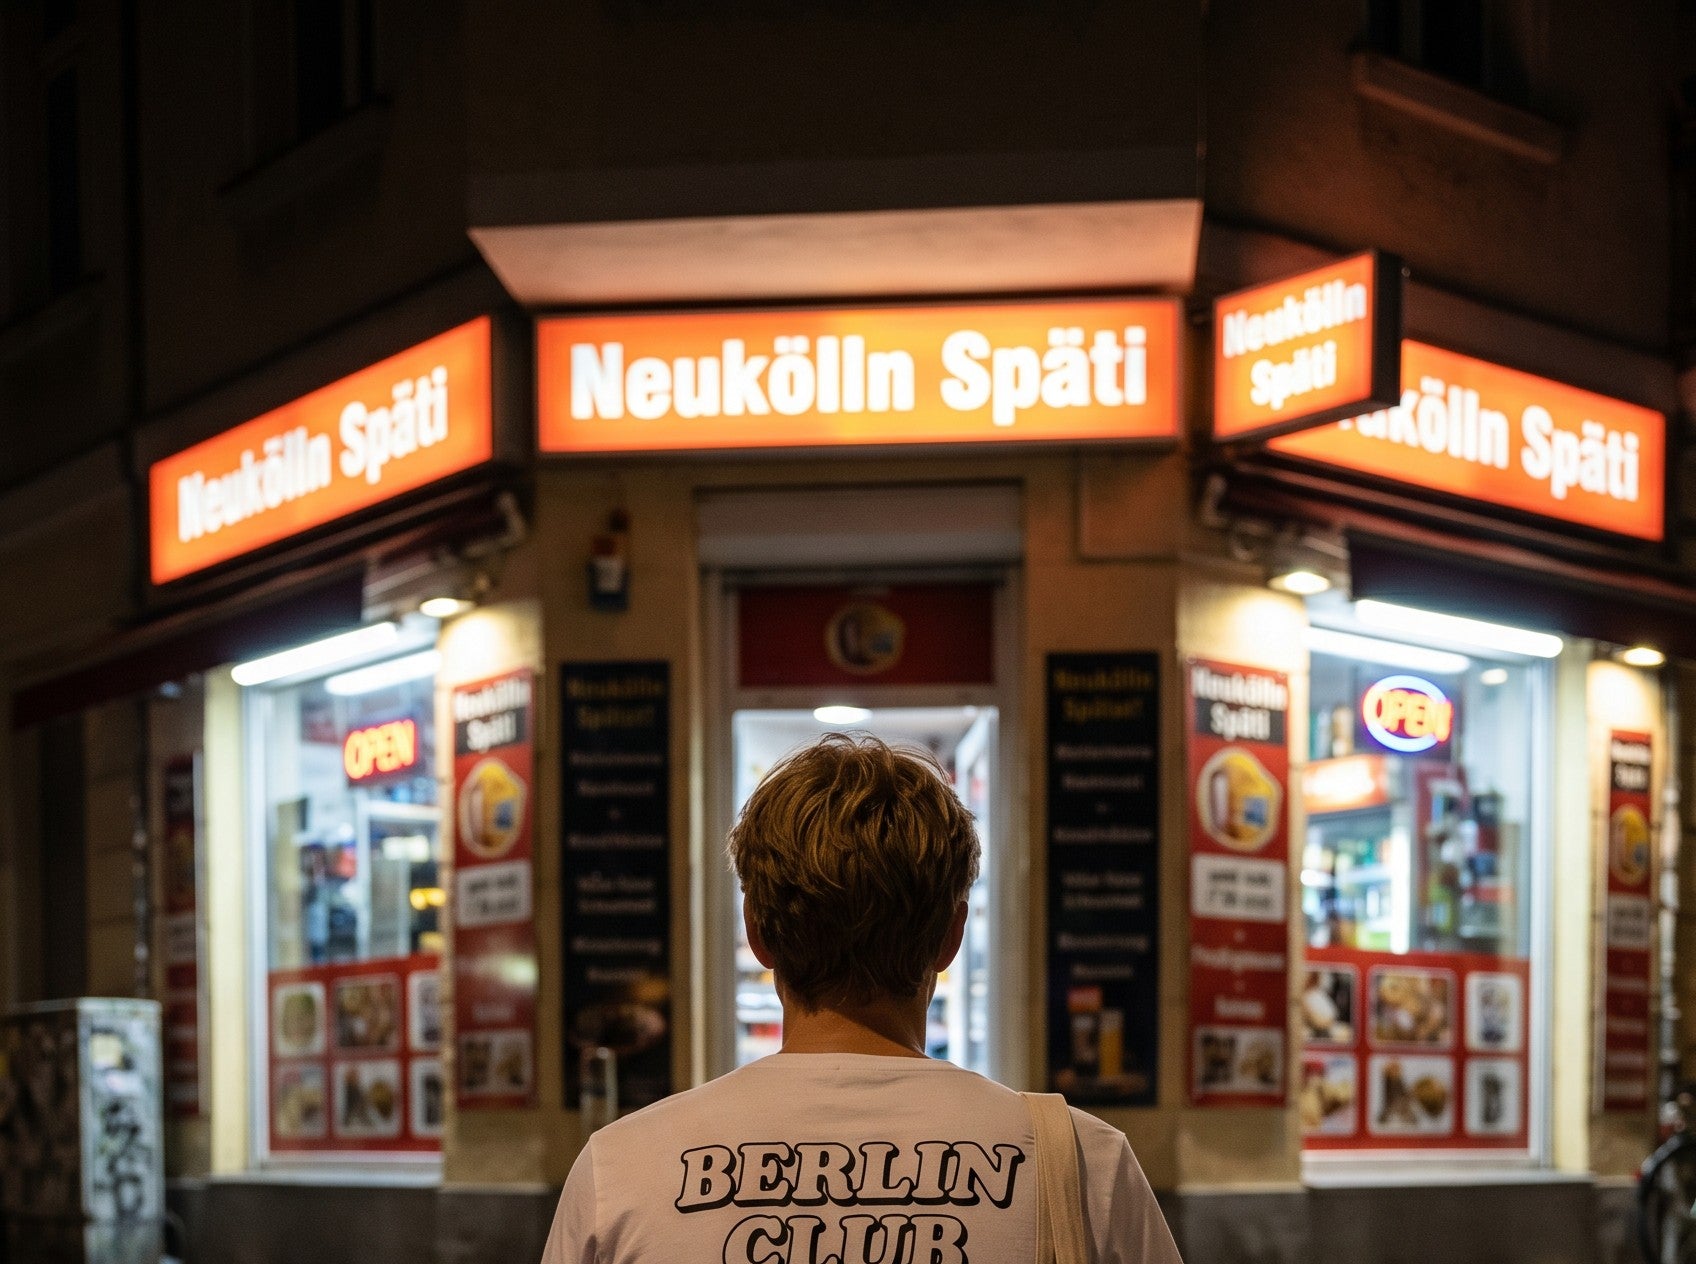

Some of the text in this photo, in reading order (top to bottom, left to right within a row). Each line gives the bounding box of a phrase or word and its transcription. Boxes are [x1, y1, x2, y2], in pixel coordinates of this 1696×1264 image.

[1223, 280, 1366, 358] Neukölln
[570, 325, 1147, 426] Neukölln Späti
[1250, 340, 1337, 410] Späti
[178, 366, 447, 542] Neukölln Späti
[1339, 375, 1639, 502] kölln Späti
[344, 718, 416, 780] OPEN
[1372, 689, 1454, 742] OPEN
[675, 1141, 1025, 1214] BERLIN
